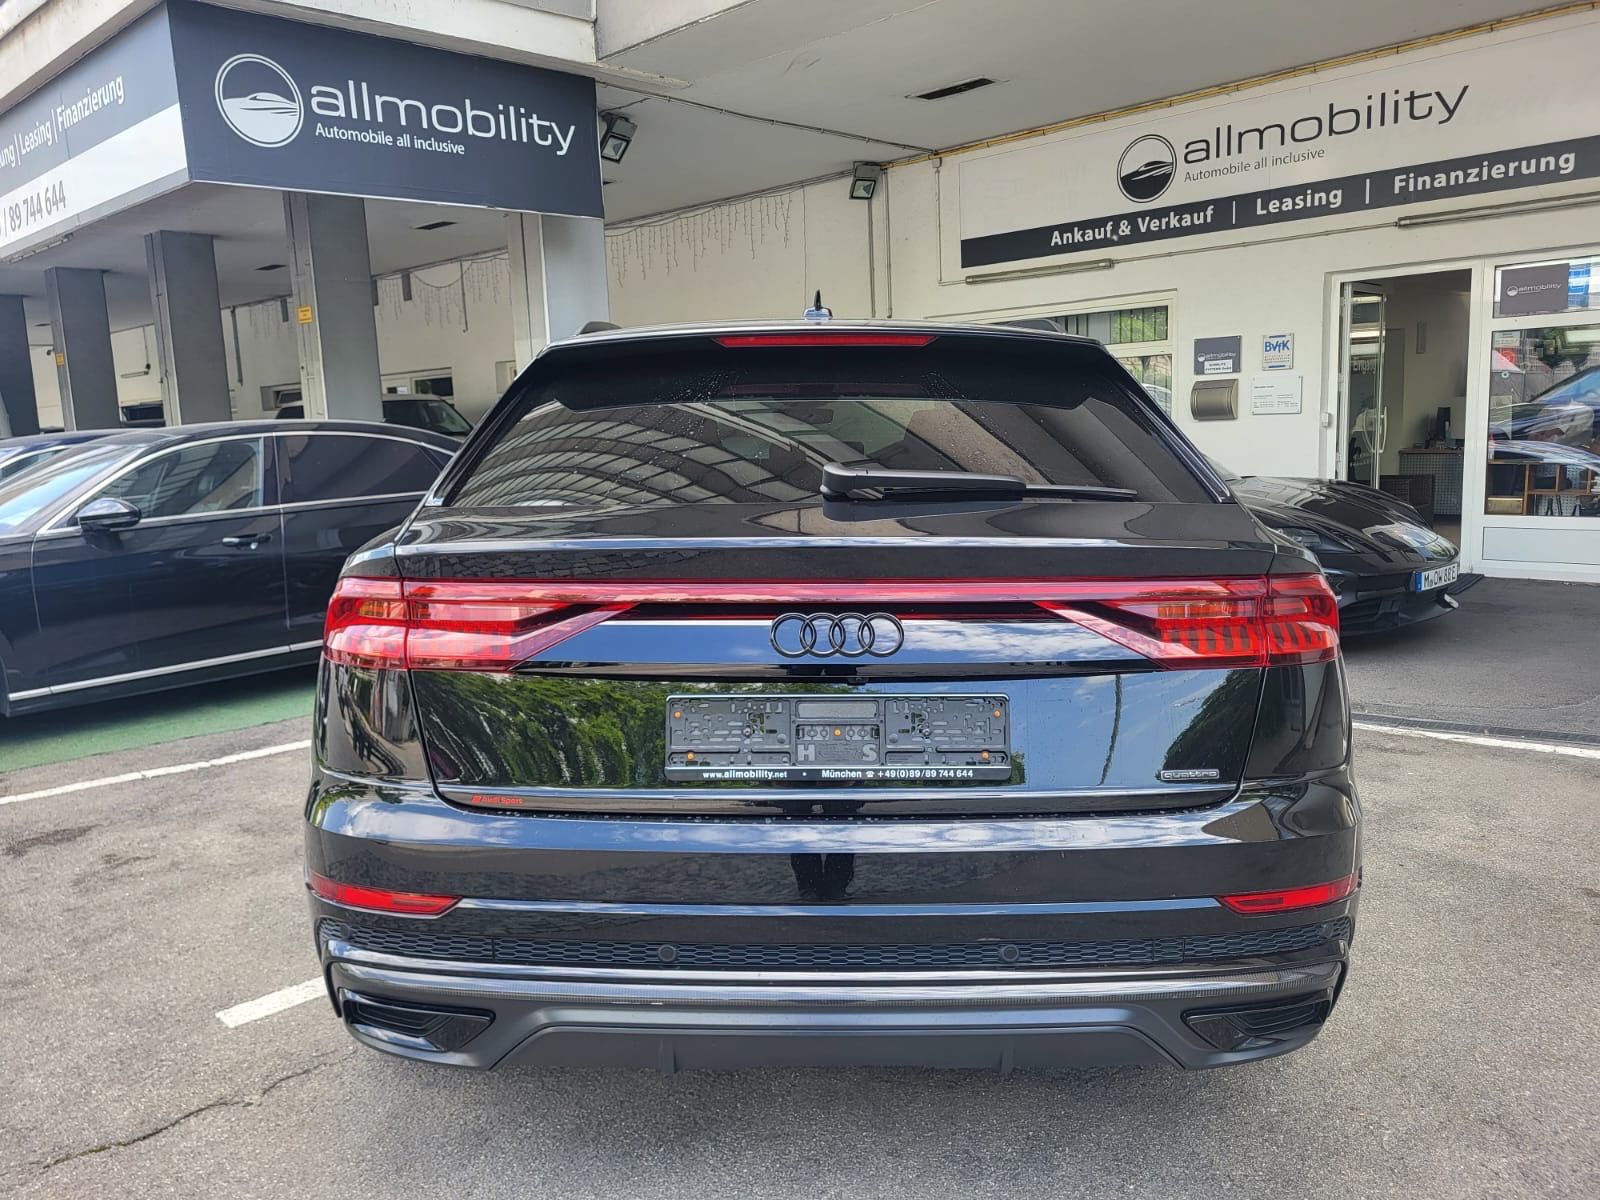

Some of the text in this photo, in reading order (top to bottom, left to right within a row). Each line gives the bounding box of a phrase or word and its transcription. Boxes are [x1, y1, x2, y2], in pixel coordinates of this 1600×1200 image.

[0, 145, 15, 168] ung
[19, 121, 52, 156] Leasing
[56, 75, 125, 132] Finanzierung
[310, 79, 576, 156] allmobility
[315, 122, 465, 156] Automobile all inclusive
[1183, 84, 1470, 165] allmobility
[1184, 148, 1325, 183] Automobile all inclusive
[9, 202, 22, 232] 89
[23, 191, 43, 226] 744
[45, 180, 66, 216] 644
[1050, 221, 1113, 247] Ankauf
[1118, 219, 1131, 236] &
[1137, 205, 1214, 233] Verkauf
[1256, 186, 1343, 215] Leasing
[1393, 152, 1576, 195] Finanzierung
[702, 769, 788, 780] www.allmobility.net
[821, 769, 973, 779] München +49(0)89/89 744 644
[1163, 770, 1218, 779] quattro
